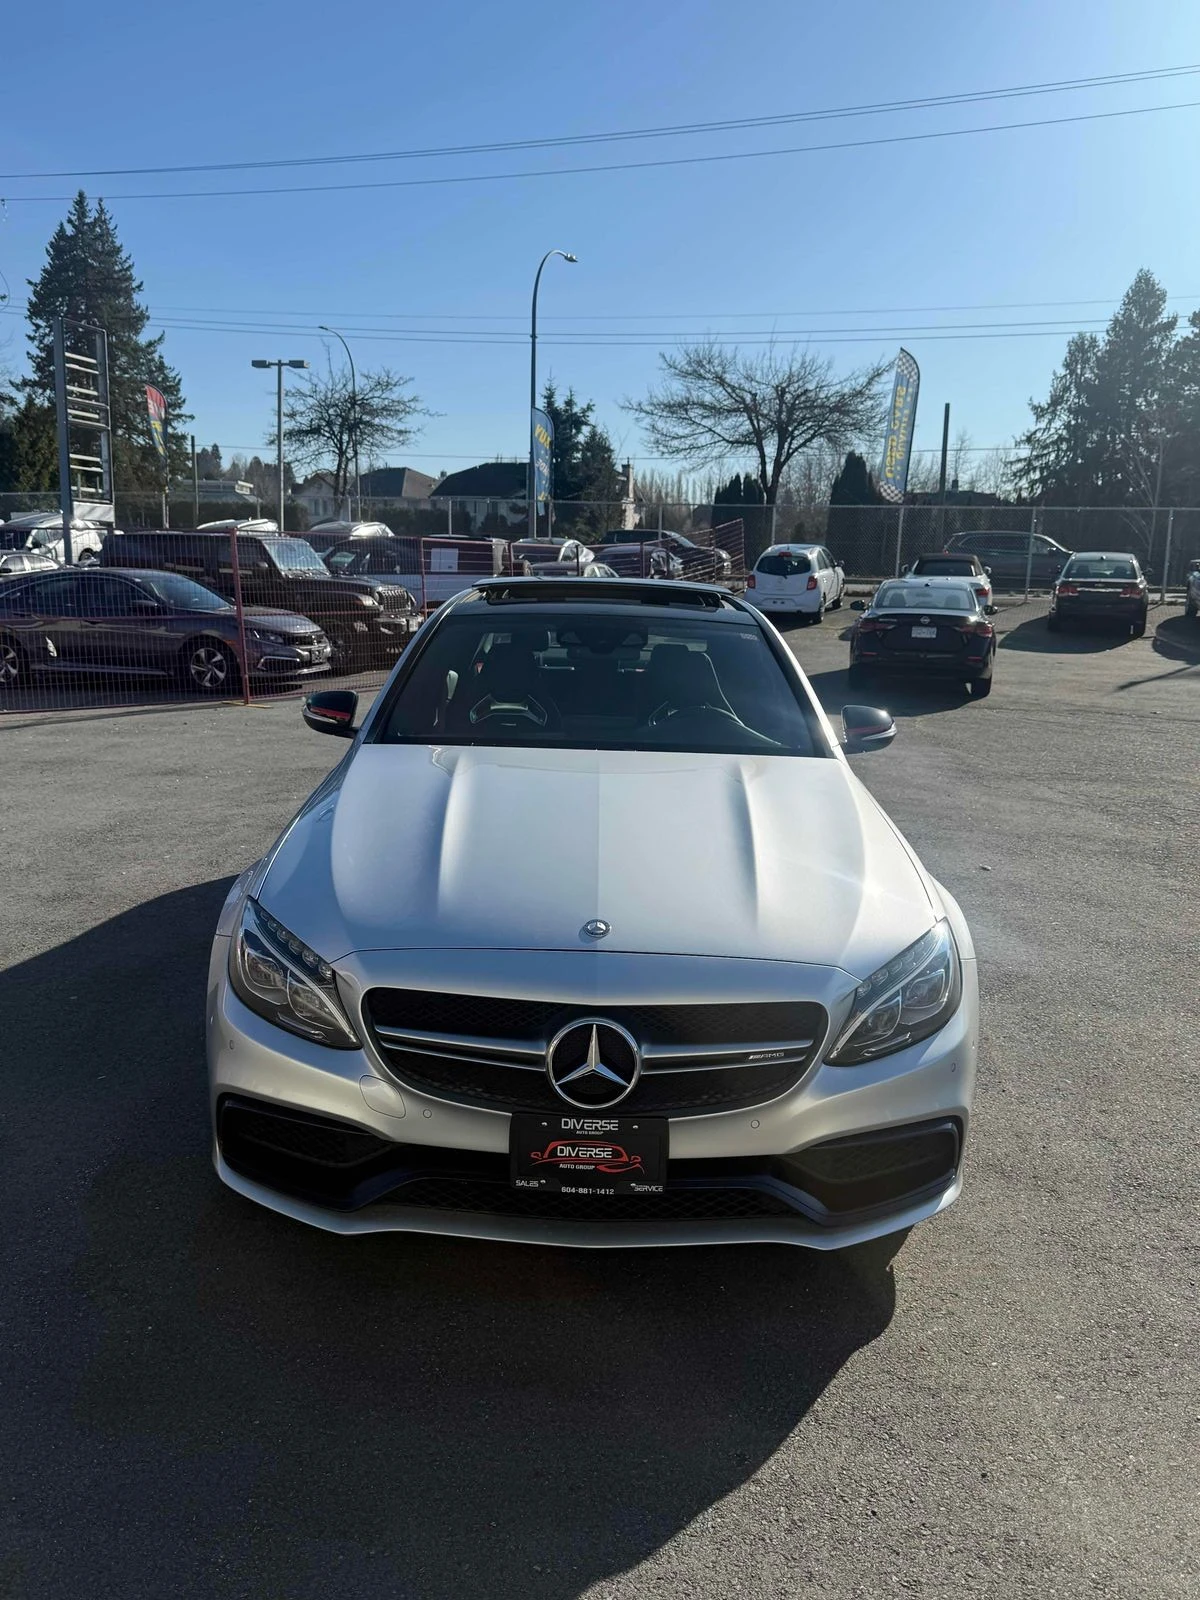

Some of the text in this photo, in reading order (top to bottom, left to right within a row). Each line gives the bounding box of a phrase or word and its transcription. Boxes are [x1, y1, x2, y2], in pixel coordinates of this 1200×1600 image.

[561, 1118, 619, 1131] DIVERSE
[557, 1146, 613, 1158] DIVERSE
[515, 1179, 539, 1188] SALES
[633, 1184, 664, 1192] SERVICE
[561, 1186, 615, 1195] 604-881-1412
